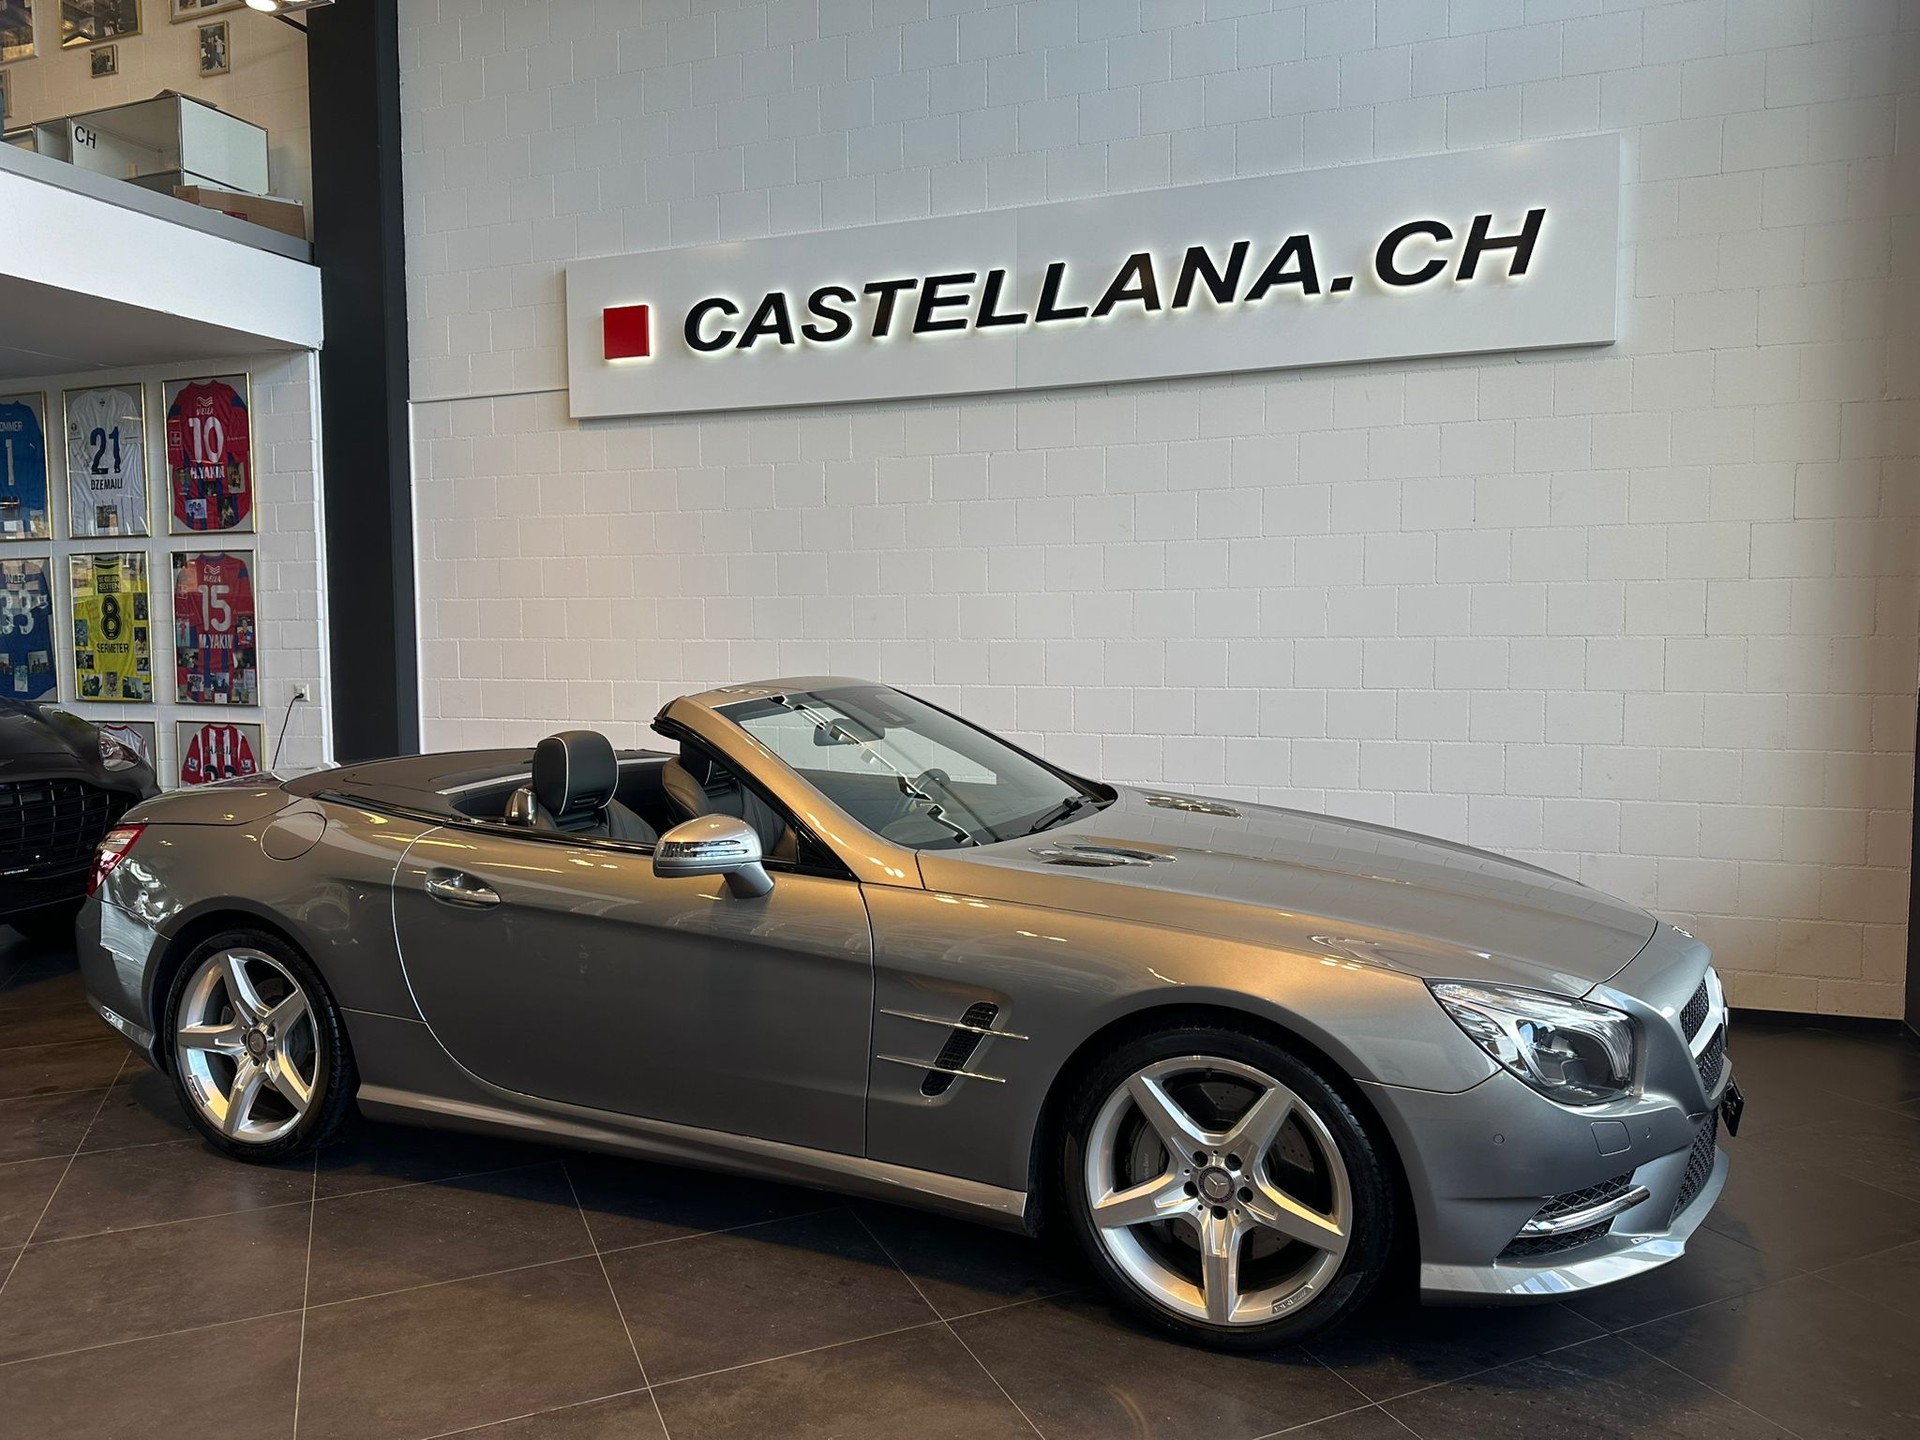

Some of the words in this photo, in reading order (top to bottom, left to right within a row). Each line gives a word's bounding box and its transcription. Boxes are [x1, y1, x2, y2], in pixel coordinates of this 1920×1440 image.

[75, 126, 96, 149] CH
[683, 208, 1547, 354] CASTELLANA.CH
[5, 439, 15, 486] 1
[90, 426, 122, 475] 21
[188, 416, 224, 464] 10
[91, 478, 123, 490] DZEMAILI
[101, 594, 122, 640] 8
[198, 585, 231, 632] 15
